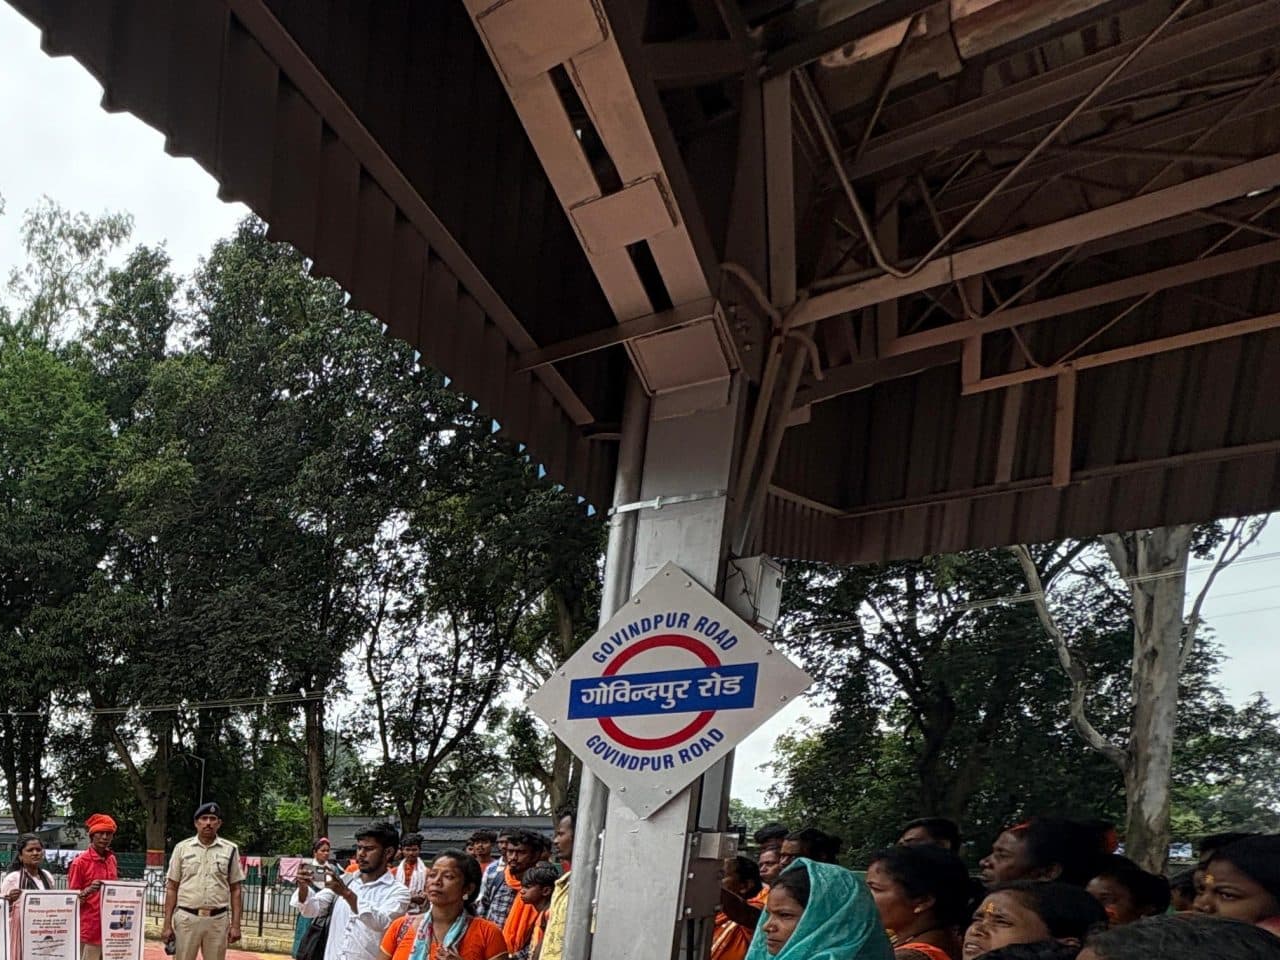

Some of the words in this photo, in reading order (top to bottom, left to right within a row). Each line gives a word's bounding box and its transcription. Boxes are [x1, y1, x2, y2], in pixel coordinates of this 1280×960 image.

[592, 612, 690, 663] GOVINDPUR
[693, 615, 738, 651] ROAD
[580, 680, 691, 709] गोविन्दपुर
[697, 672, 744, 697] रोड
[586, 734, 674, 772] GOVINDPUR
[678, 727, 725, 763] ROAD
